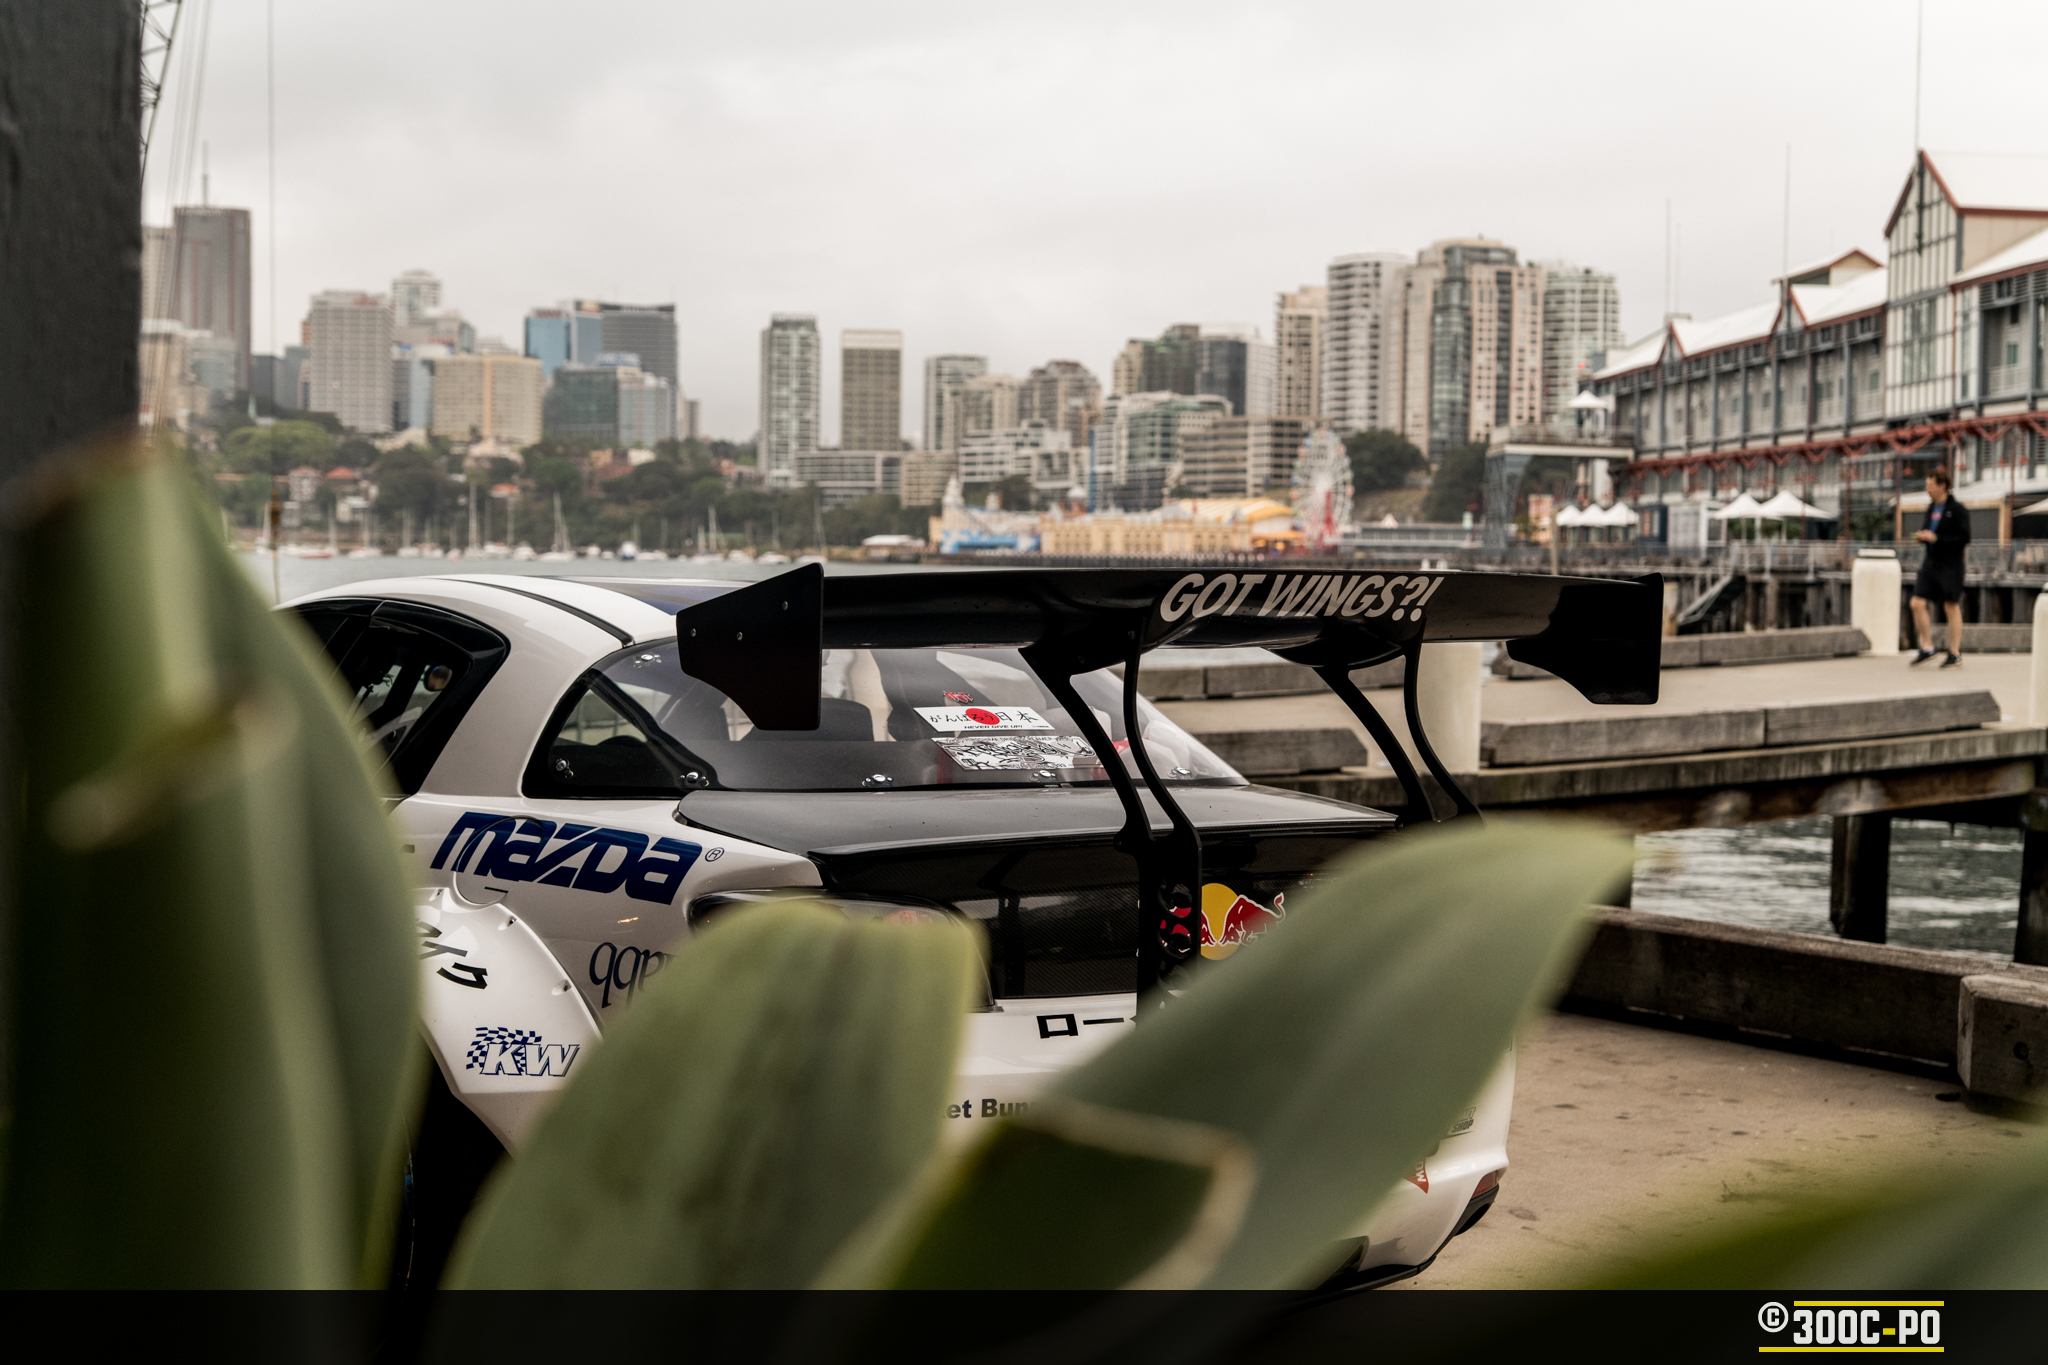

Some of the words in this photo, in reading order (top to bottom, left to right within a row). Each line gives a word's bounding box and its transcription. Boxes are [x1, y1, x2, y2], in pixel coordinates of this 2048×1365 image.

[1160, 573, 1267, 622] GOT
[1257, 574, 1445, 622] WINGS?!
[479, 1043, 580, 1077] KW
[943, 1099, 972, 1119] et
[981, 1098, 1035, 1118] Bun
